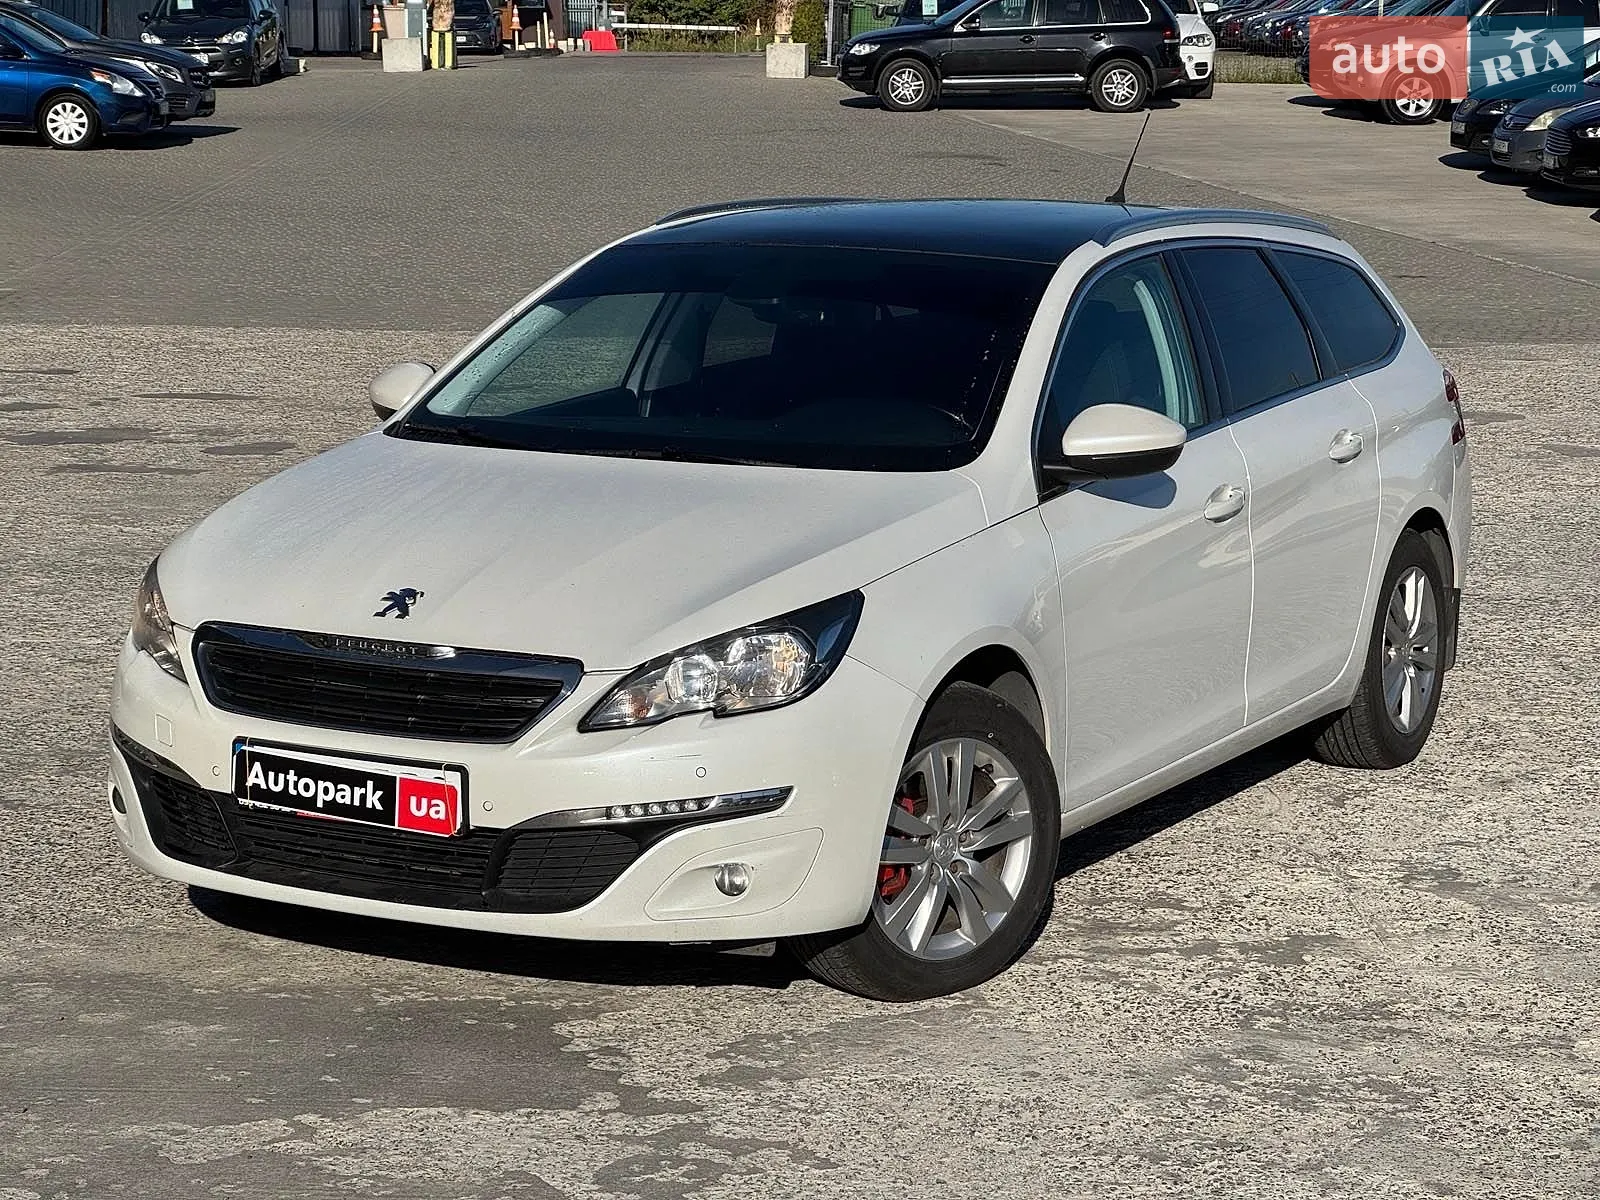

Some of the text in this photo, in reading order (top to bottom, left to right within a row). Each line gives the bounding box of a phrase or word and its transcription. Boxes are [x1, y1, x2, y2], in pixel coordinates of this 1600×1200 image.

[334, 637, 419, 655] PEUGEOT
[246, 761, 447, 821] Autopark ua
